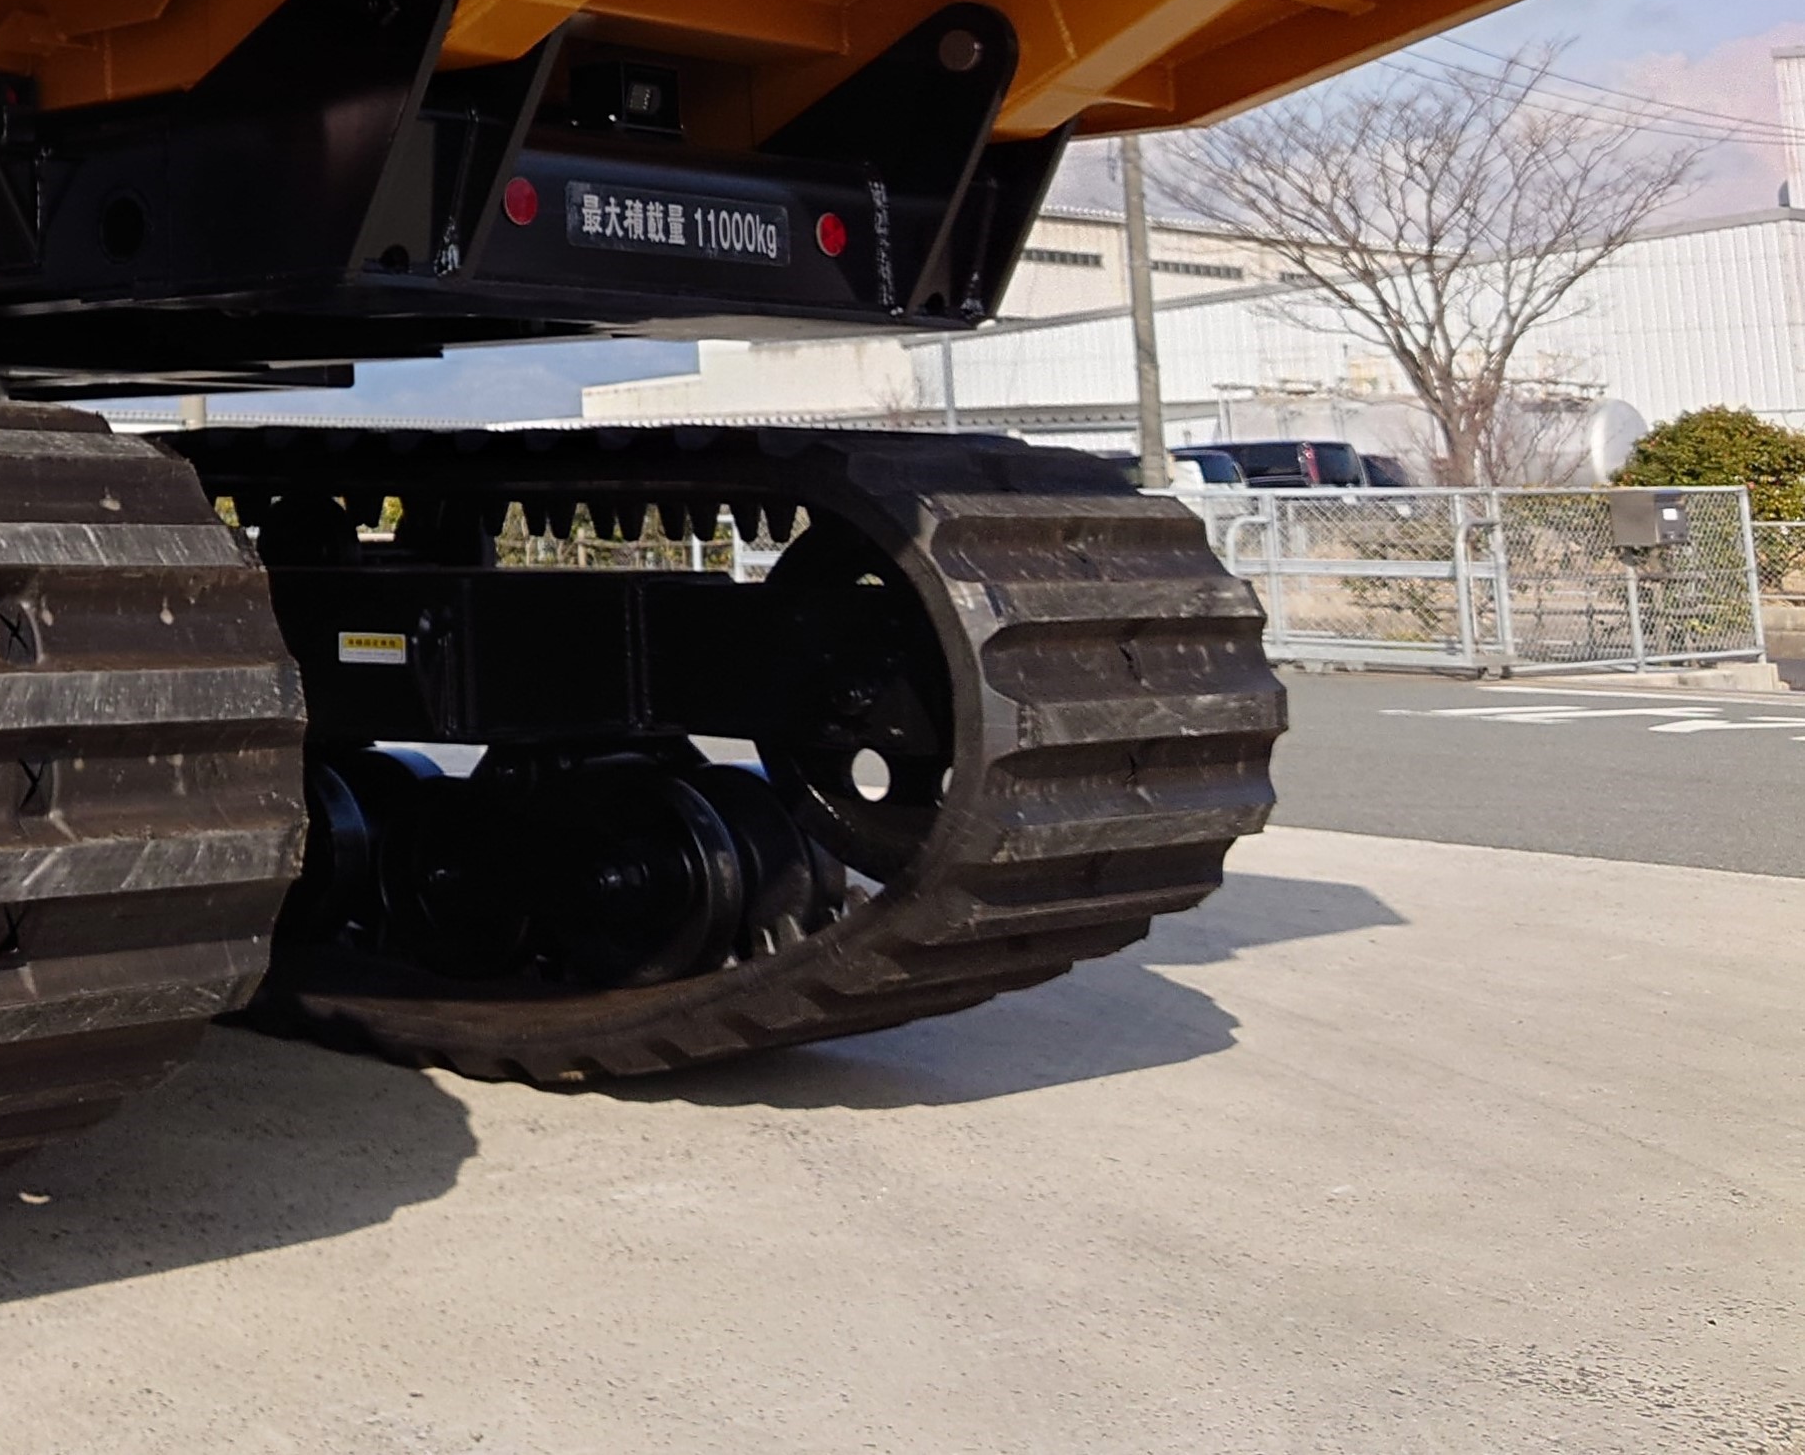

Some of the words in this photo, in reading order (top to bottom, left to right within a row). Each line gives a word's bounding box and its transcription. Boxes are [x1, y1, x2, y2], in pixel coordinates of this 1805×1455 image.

[581, 193, 686, 246] 最大積載量
[693, 206, 778, 260] 11000kg
